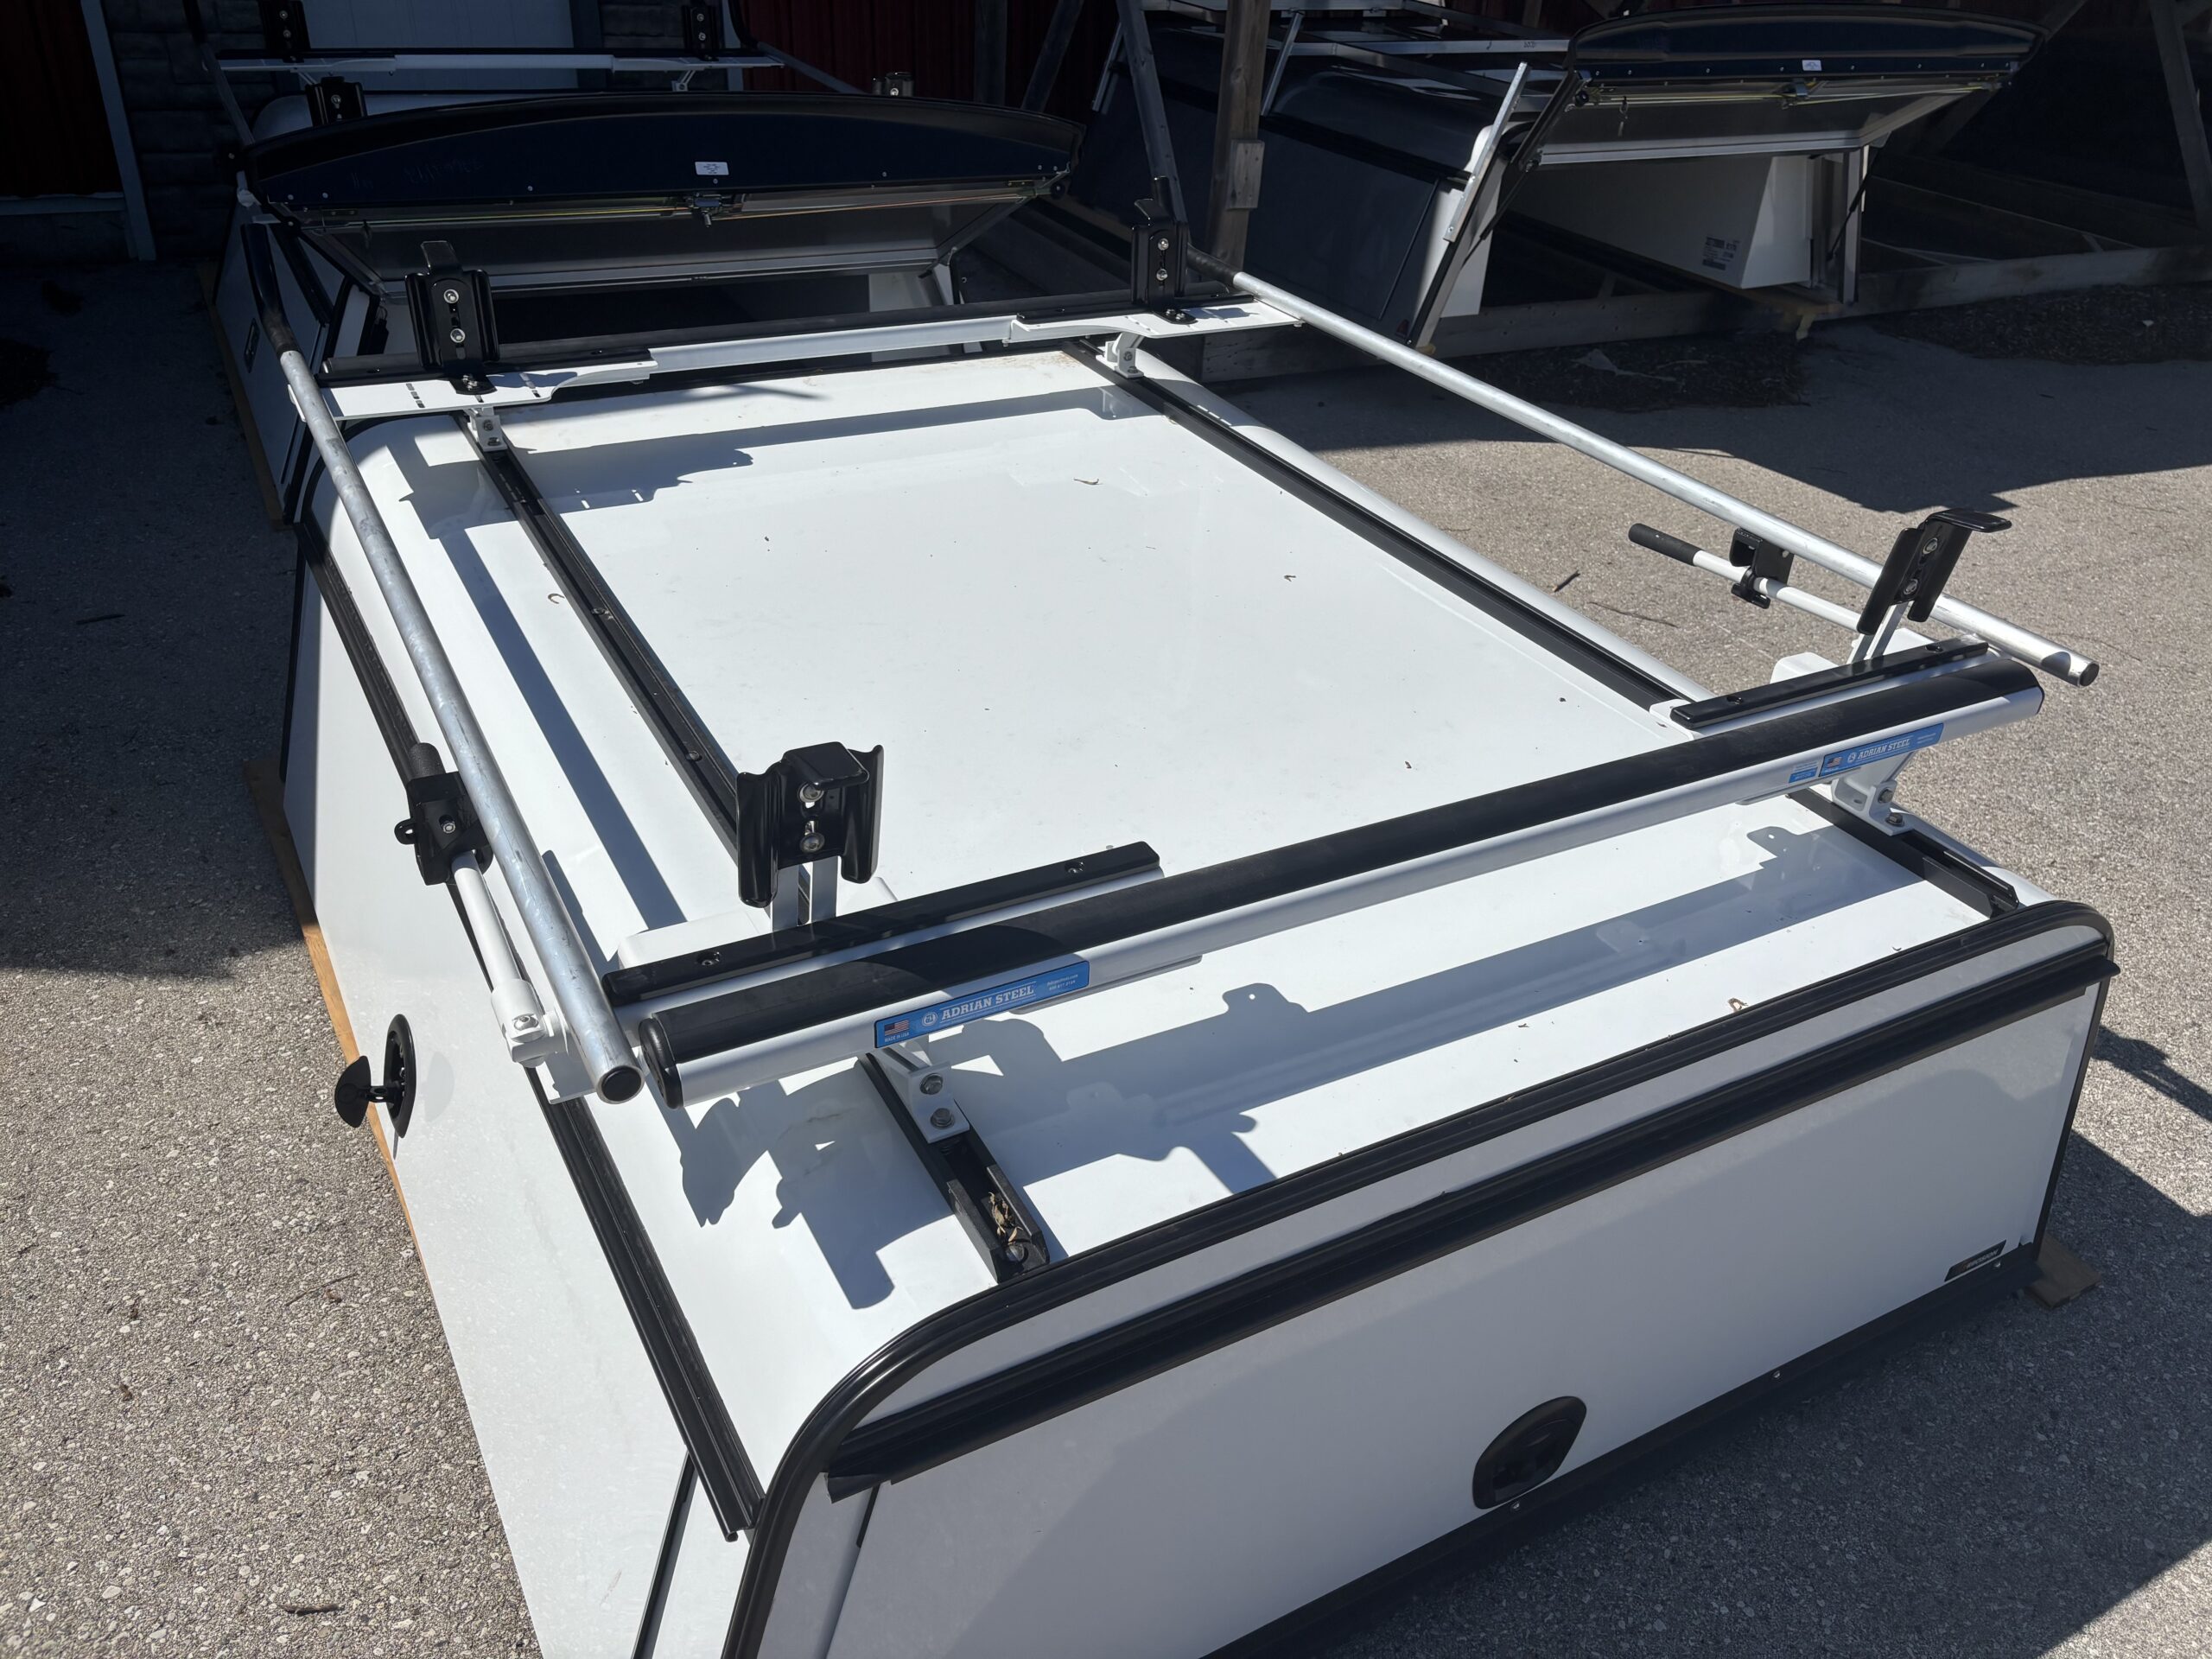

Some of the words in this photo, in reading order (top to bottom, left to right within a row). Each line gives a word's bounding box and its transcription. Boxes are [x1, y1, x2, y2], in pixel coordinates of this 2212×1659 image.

[1857, 746, 1887, 760] ADRIAN
[1887, 739, 1911, 752] STEEL
[941, 998, 992, 1020] ADRIAN
[995, 985, 1034, 1005] STEEL
